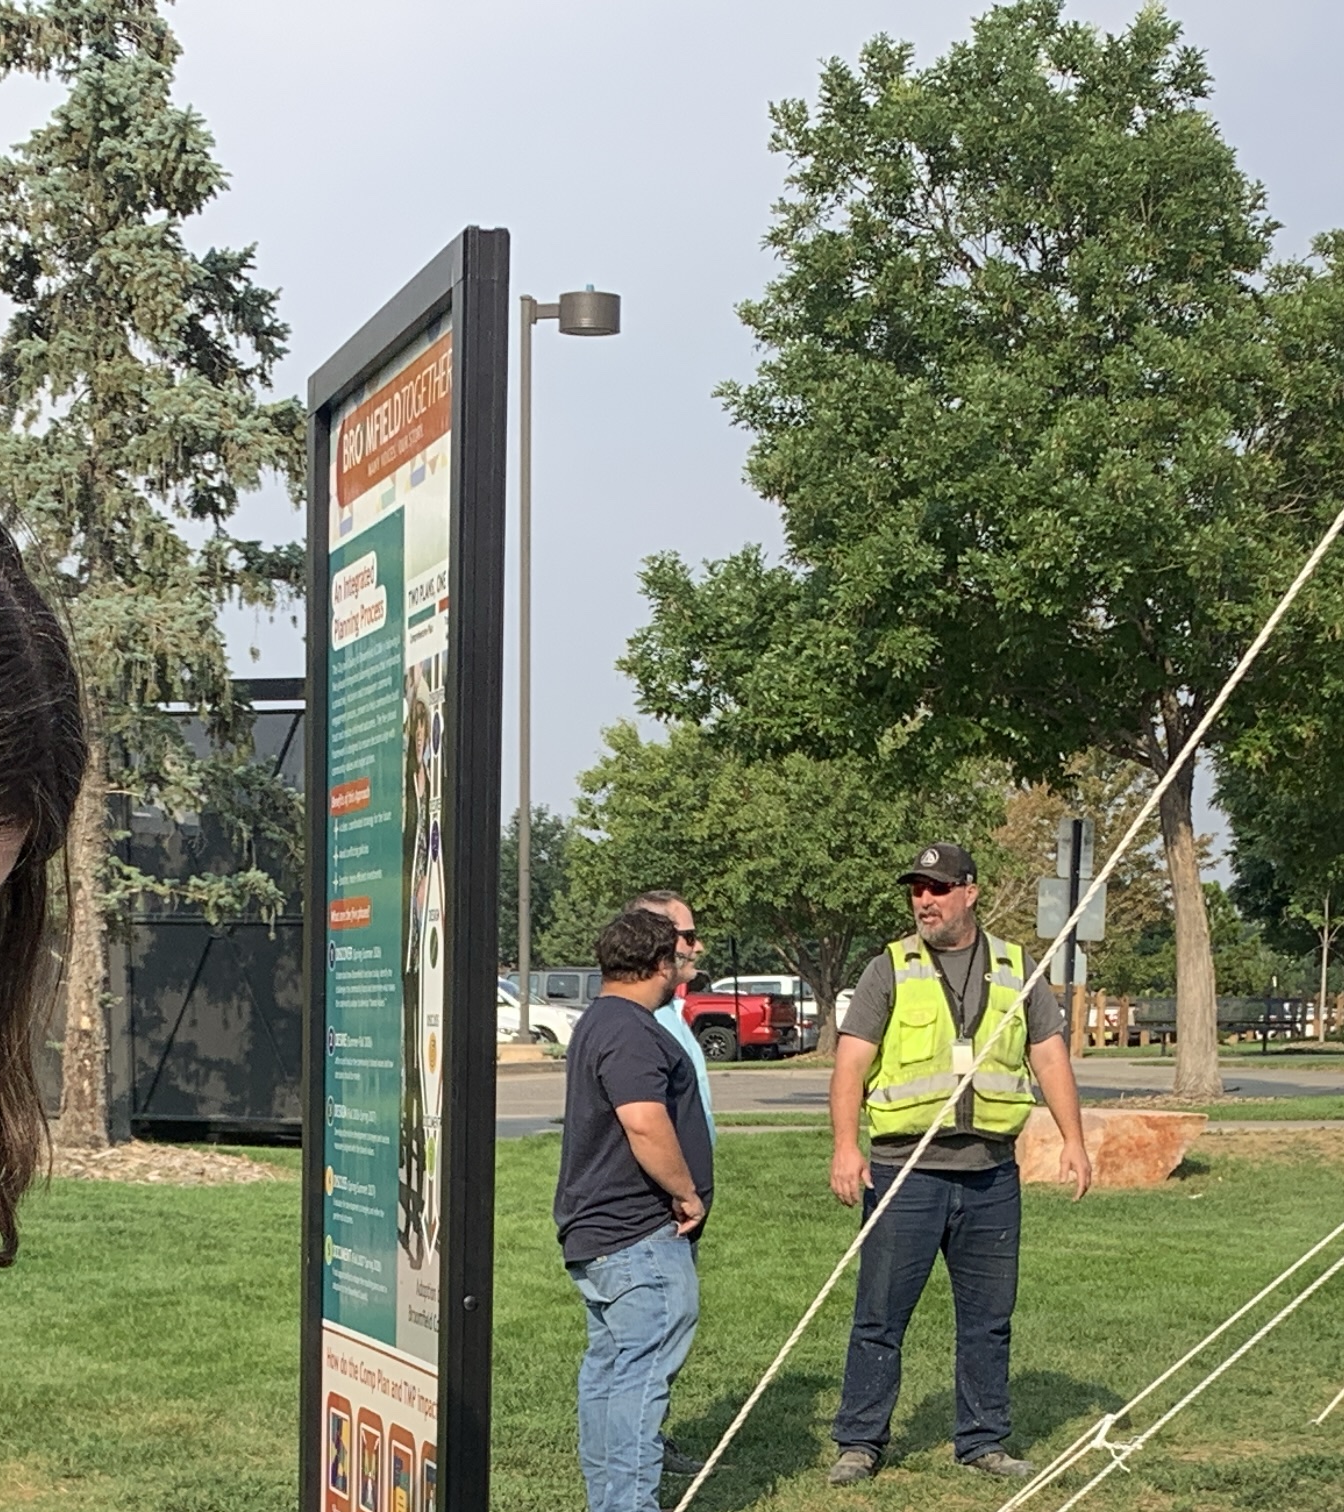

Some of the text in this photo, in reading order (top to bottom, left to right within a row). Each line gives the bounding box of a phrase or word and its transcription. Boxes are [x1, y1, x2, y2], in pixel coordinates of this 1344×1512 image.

[335, 557, 375, 605] An Integrated
[334, 599, 384, 642] Planning Process
[416, 1278, 436, 1303] Adoption
[408, 1304, 432, 1331] Broomfield
[327, 1347, 339, 1370] How
[340, 1352, 347, 1375] do
[348, 1356, 358, 1381] the
[359, 1361, 376, 1394] Comp
[377, 1368, 390, 1396] Plan
[391, 1379, 403, 1402] and
[403, 1381, 417, 1408] TMP
